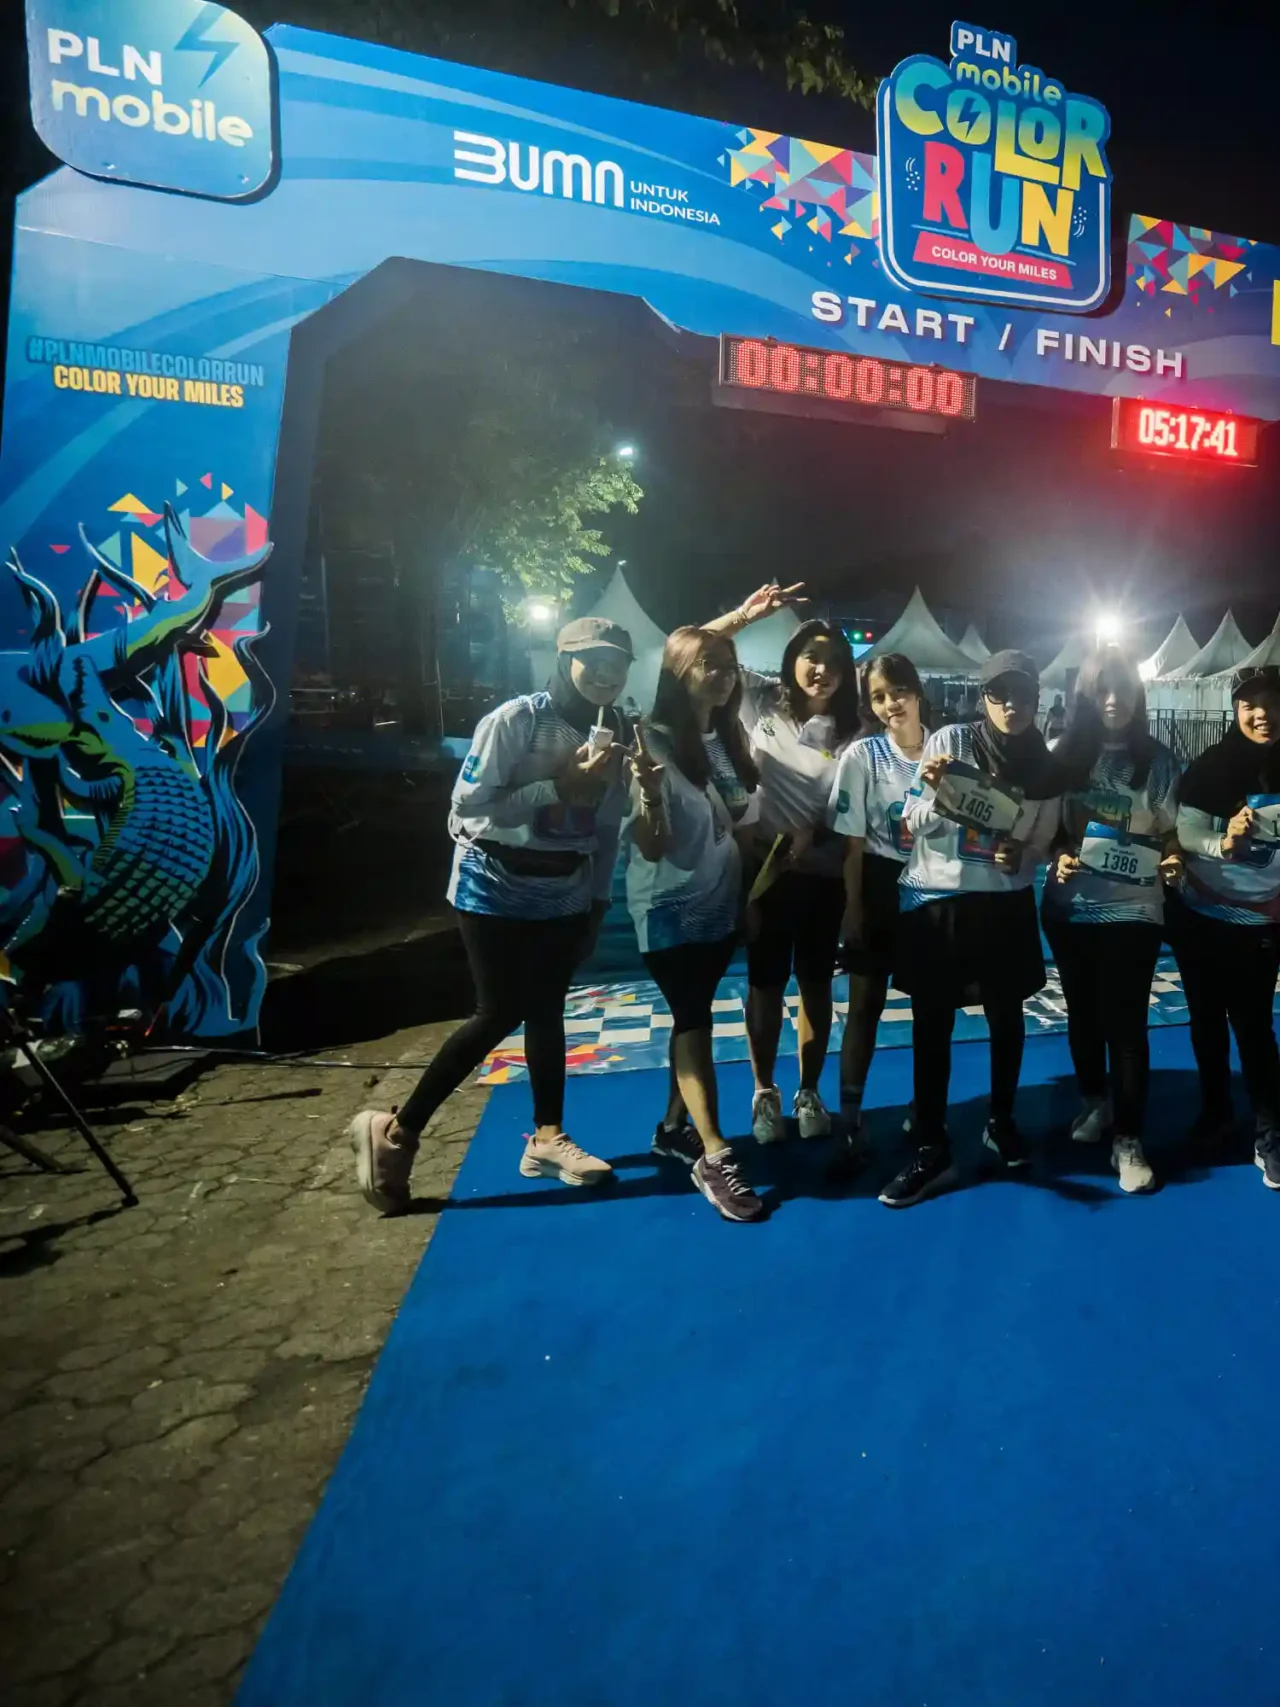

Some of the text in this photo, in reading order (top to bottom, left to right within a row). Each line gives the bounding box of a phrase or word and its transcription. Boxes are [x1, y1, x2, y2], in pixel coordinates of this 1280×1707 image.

[48, 28, 162, 86] PLN
[957, 29, 1011, 62] PLN
[956, 62, 1062, 105] mobile
[52, 79, 254, 148] mobile
[895, 62, 1106, 190] COLOR
[453, 130, 624, 207] BUMN
[630, 181, 689, 202] UNTUK
[630, 198, 721, 225] INDONESIA
[923, 141, 1074, 256] RUN
[931, 246, 1057, 281] COLOR YOUR MILES
[811, 291, 974, 343] START
[1037, 329, 1184, 378] FINISH
[27, 337, 264, 386] #PLNMOBILECOLORRUN
[736, 341, 964, 416] 00:00:00
[54, 366, 244, 408] COLOR YOUR MILES
[1138, 407, 1238, 457] 05:17:41
[956, 792, 995, 822] 1405
[1101, 852, 1138, 874] 1386
